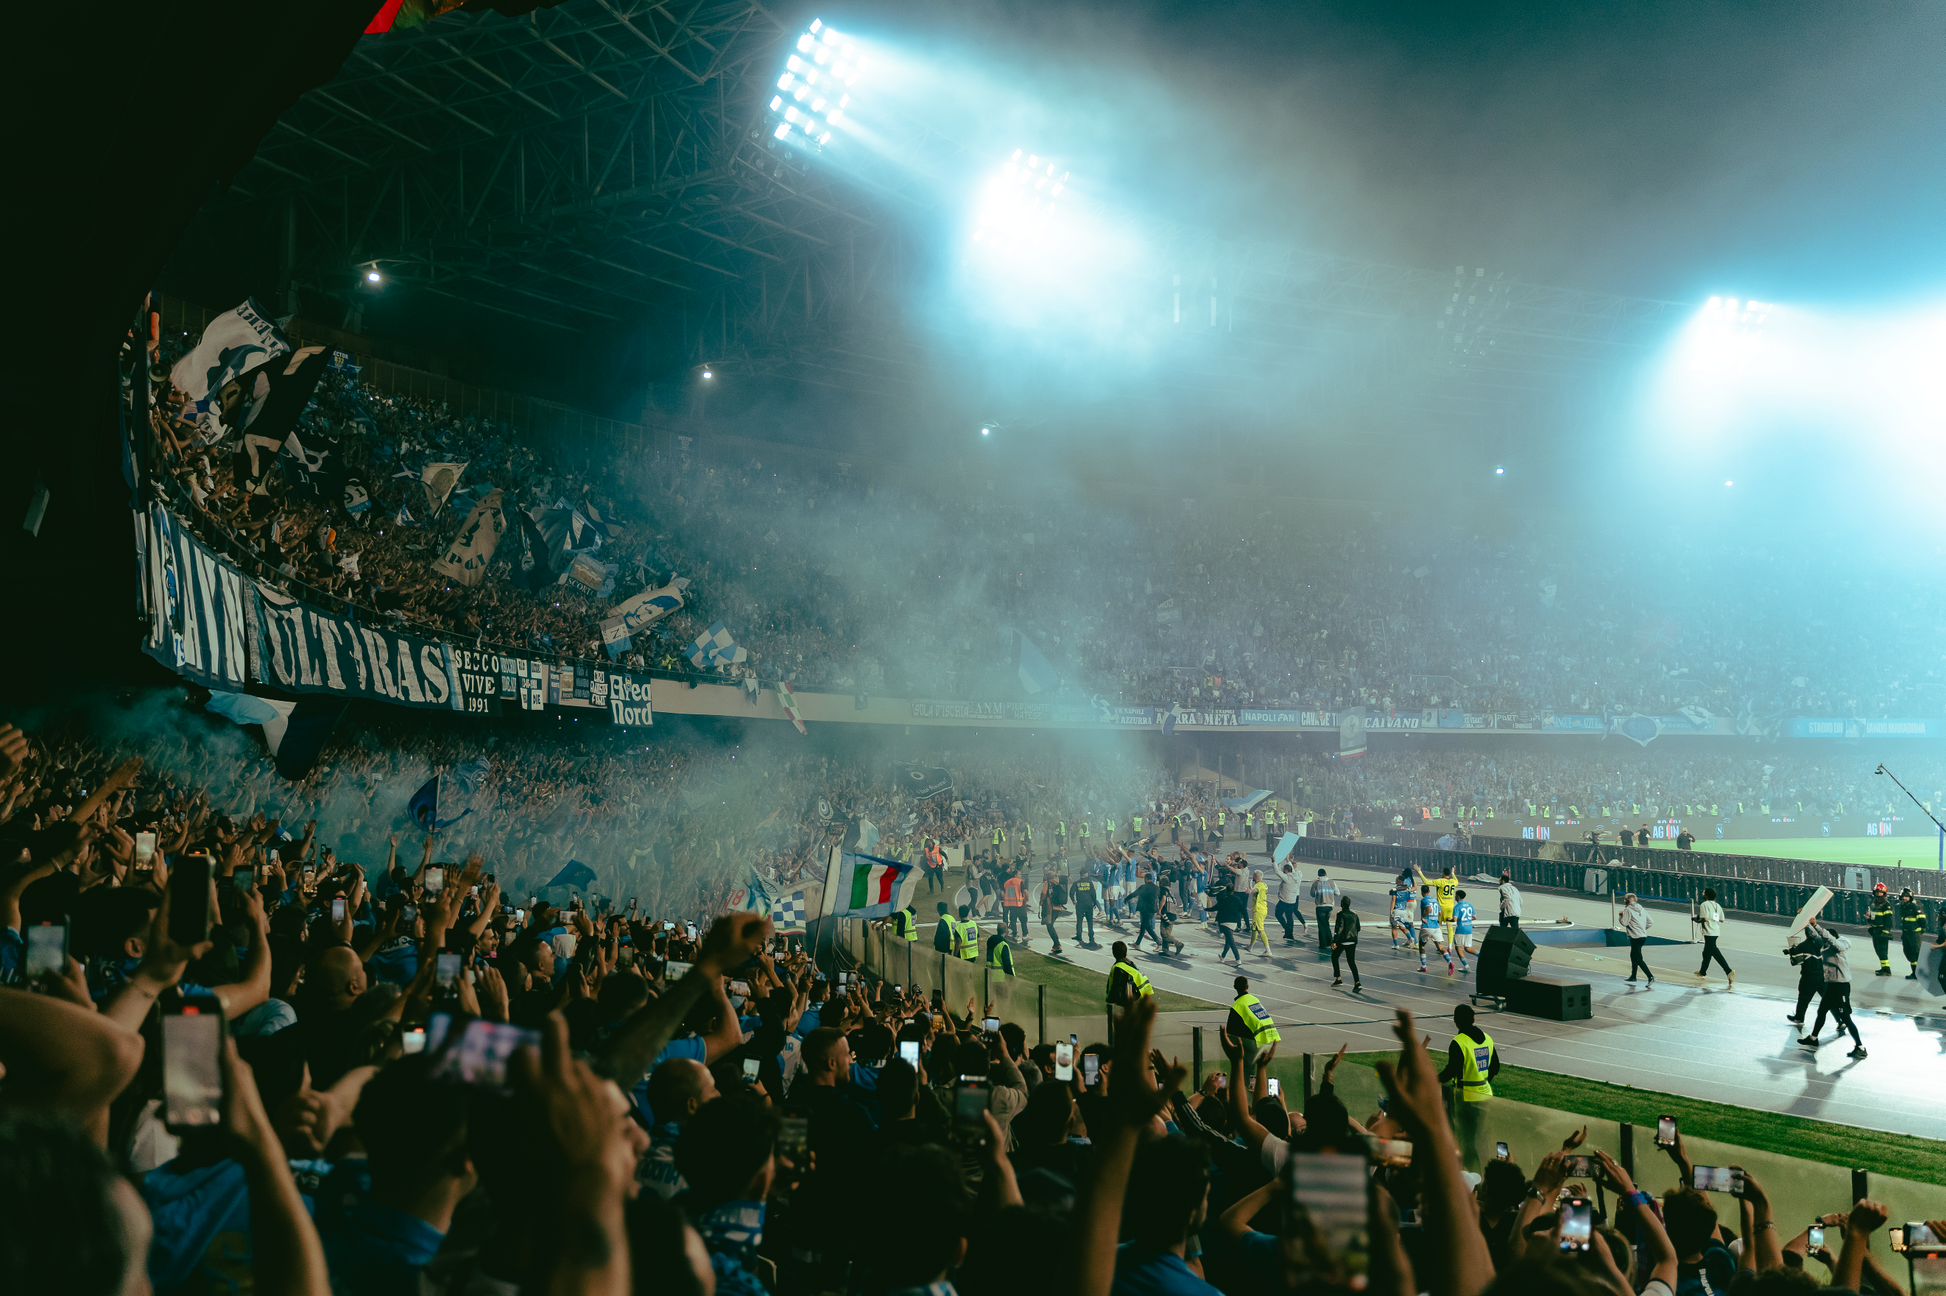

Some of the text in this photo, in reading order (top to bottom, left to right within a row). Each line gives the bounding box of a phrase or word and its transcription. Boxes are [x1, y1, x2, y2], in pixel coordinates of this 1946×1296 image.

[264, 606, 449, 705] ULTRAS
[455, 649, 500, 673] SECCO
[462, 673, 496, 695] VIVE
[468, 697, 489, 713] 1991
[611, 700, 653, 725] Nord
[1121, 716, 1152, 725] AZZURRA
[1203, 713, 1238, 725] META
[1245, 712, 1276, 722] NAPOLI
[1808, 722, 1833, 733] STADIO
[1888, 722, 1926, 734] MARADONA
[1460, 906, 1473, 922] 29
